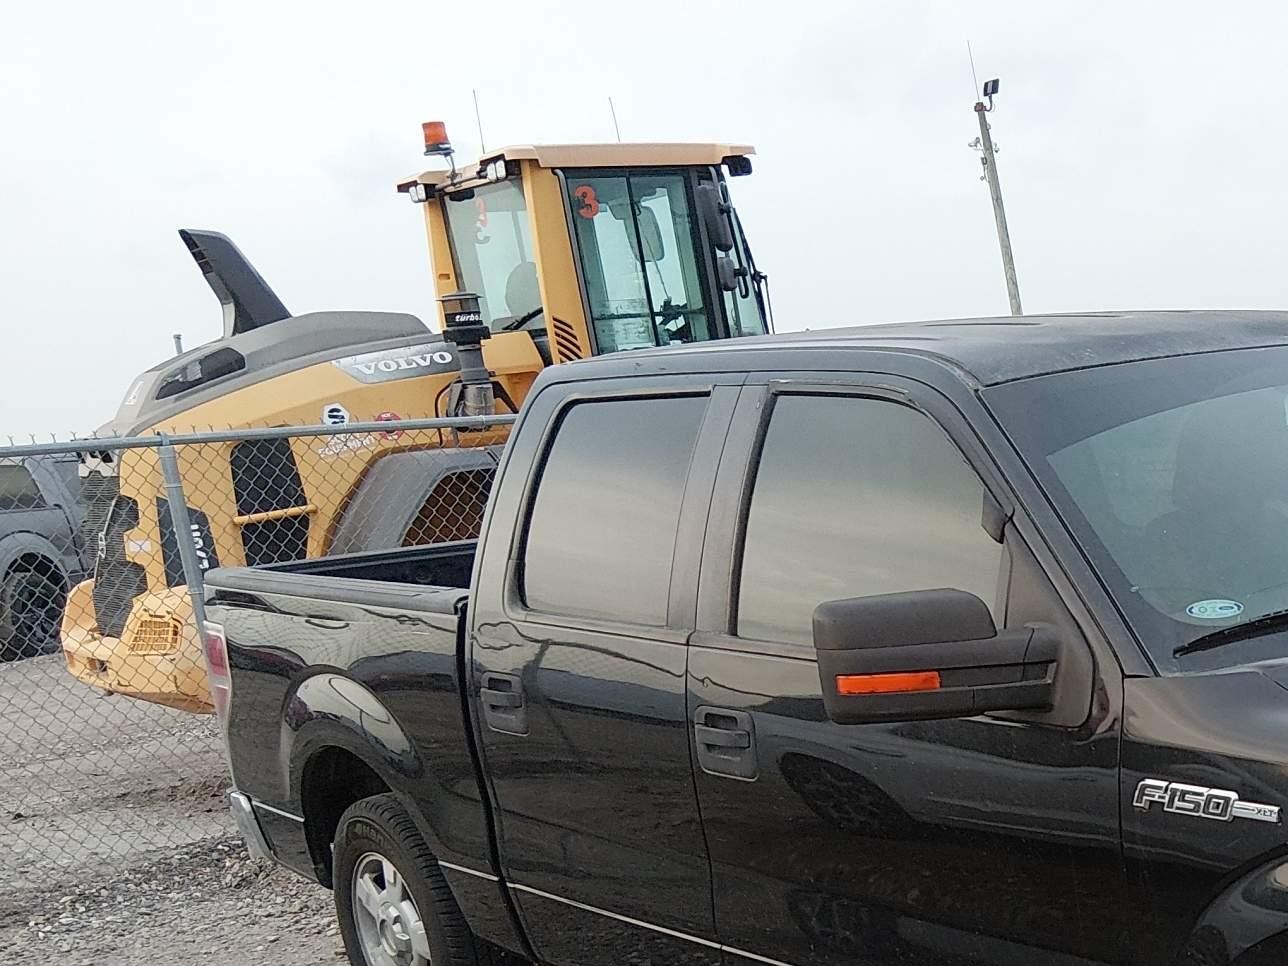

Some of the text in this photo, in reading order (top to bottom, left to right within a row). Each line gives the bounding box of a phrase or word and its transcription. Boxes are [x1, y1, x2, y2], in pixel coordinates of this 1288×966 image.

[574, 184, 600, 218] 3
[352, 351, 453, 375] VOLVO
[1132, 779, 1239, 822] F-150
